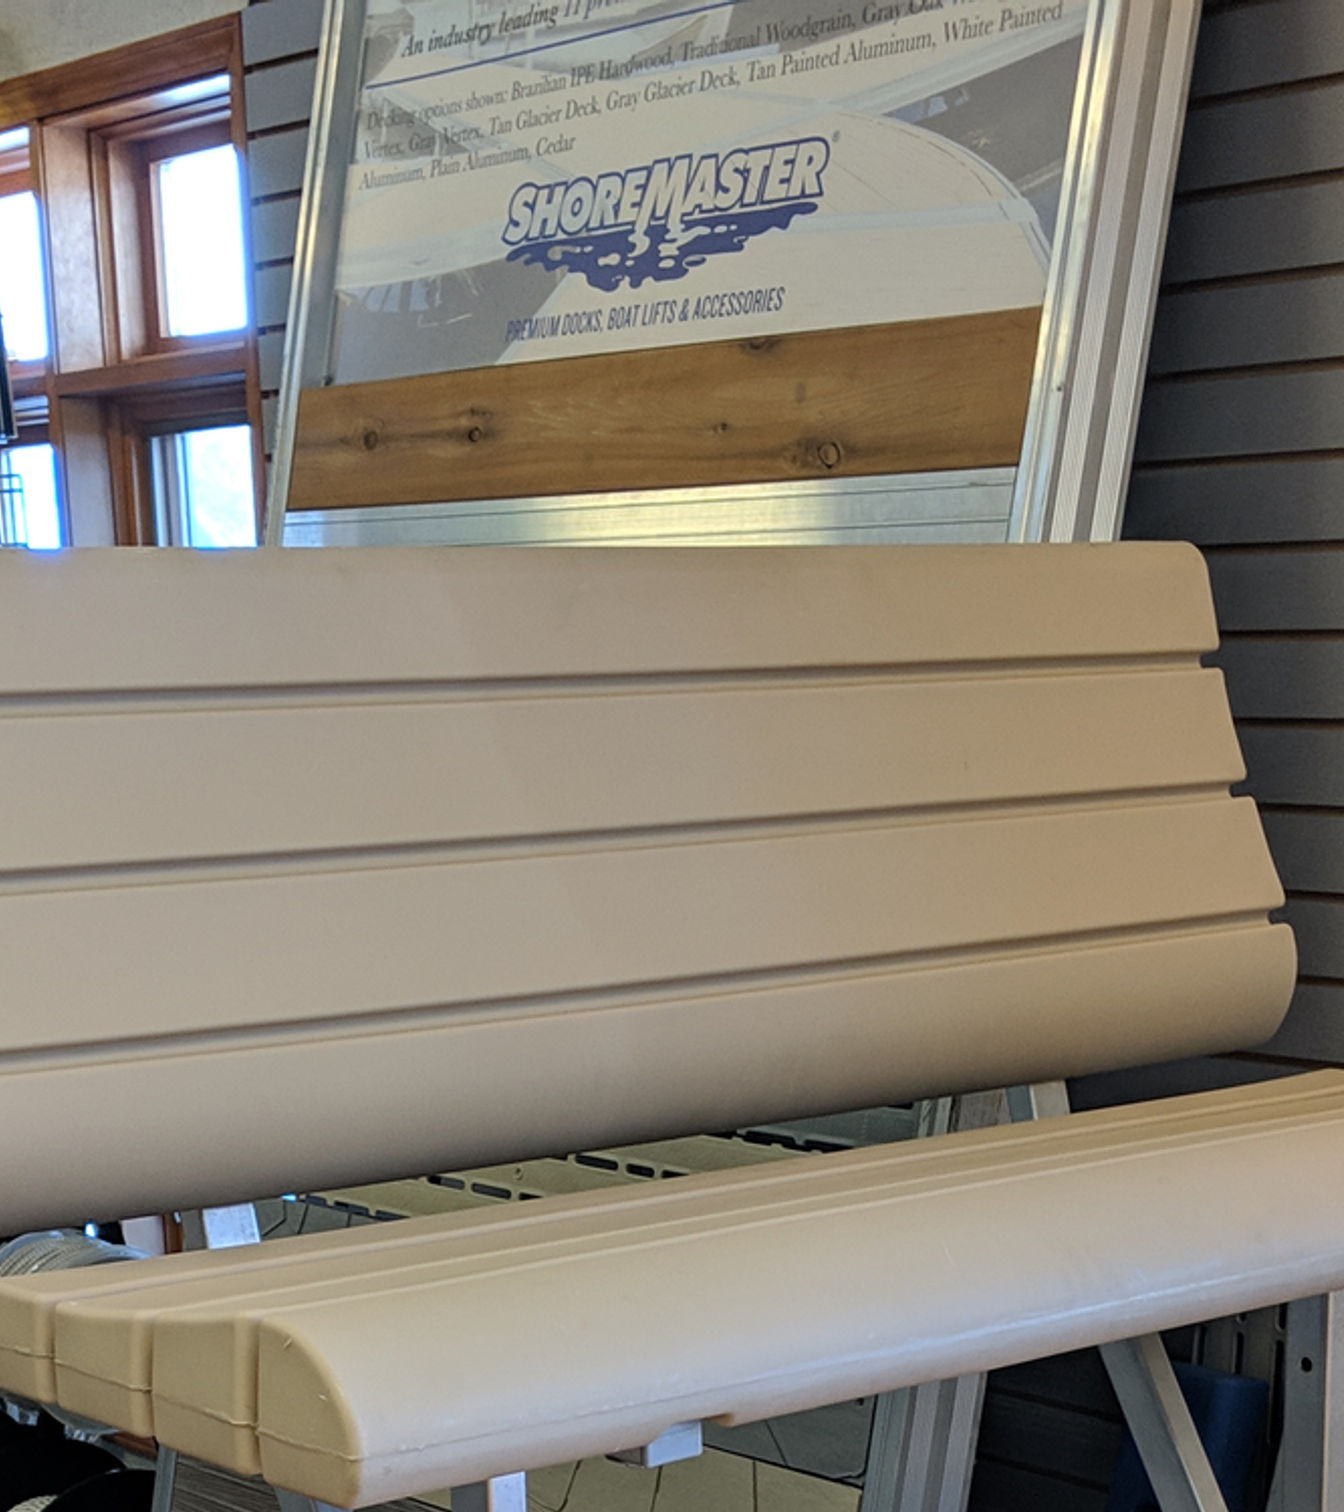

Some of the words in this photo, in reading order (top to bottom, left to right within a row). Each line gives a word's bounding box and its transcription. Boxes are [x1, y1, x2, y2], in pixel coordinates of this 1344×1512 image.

[401, 35, 423, 57] An
[429, 21, 494, 46] industry
[499, 5, 558, 33] leading
[465, 92, 507, 112] shown:
[510, 74, 565, 101] Brazilian
[571, 64, 596, 87] IPE
[597, 49, 675, 81] Hardwood,
[679, 30, 761, 61] Traditional
[765, 14, 856, 44] Woodgrain,
[862, 4, 900, 25] Gray
[489, 117, 511, 136] Tan
[516, 104, 561, 130] Glacier
[565, 97, 601, 120] Deck,
[606, 90, 640, 115] Gray
[644, 77, 694, 102] Glacier
[699, 66, 741, 90] Deck,
[747, 60, 776, 82] Tan
[781, 44, 840, 77] Painted
[844, 32, 937, 65] Aluminum,
[944, 16, 994, 43] White
[999, 1, 1064, 32] Painted
[359, 166, 426, 190] Aluminum,
[430, 156, 460, 178] Plain
[463, 147, 532, 172] Aluminum,
[537, 135, 577, 157] Cedar
[501, 136, 831, 246] SHOREMASTER
[505, 314, 560, 343] PREMIUM
[561, 310, 604, 336] DOCKS,
[607, 304, 640, 329] BOAT
[642, 301, 677, 326] LIFTS
[679, 298, 691, 321] &
[692, 286, 786, 321] ACCESSORIES
